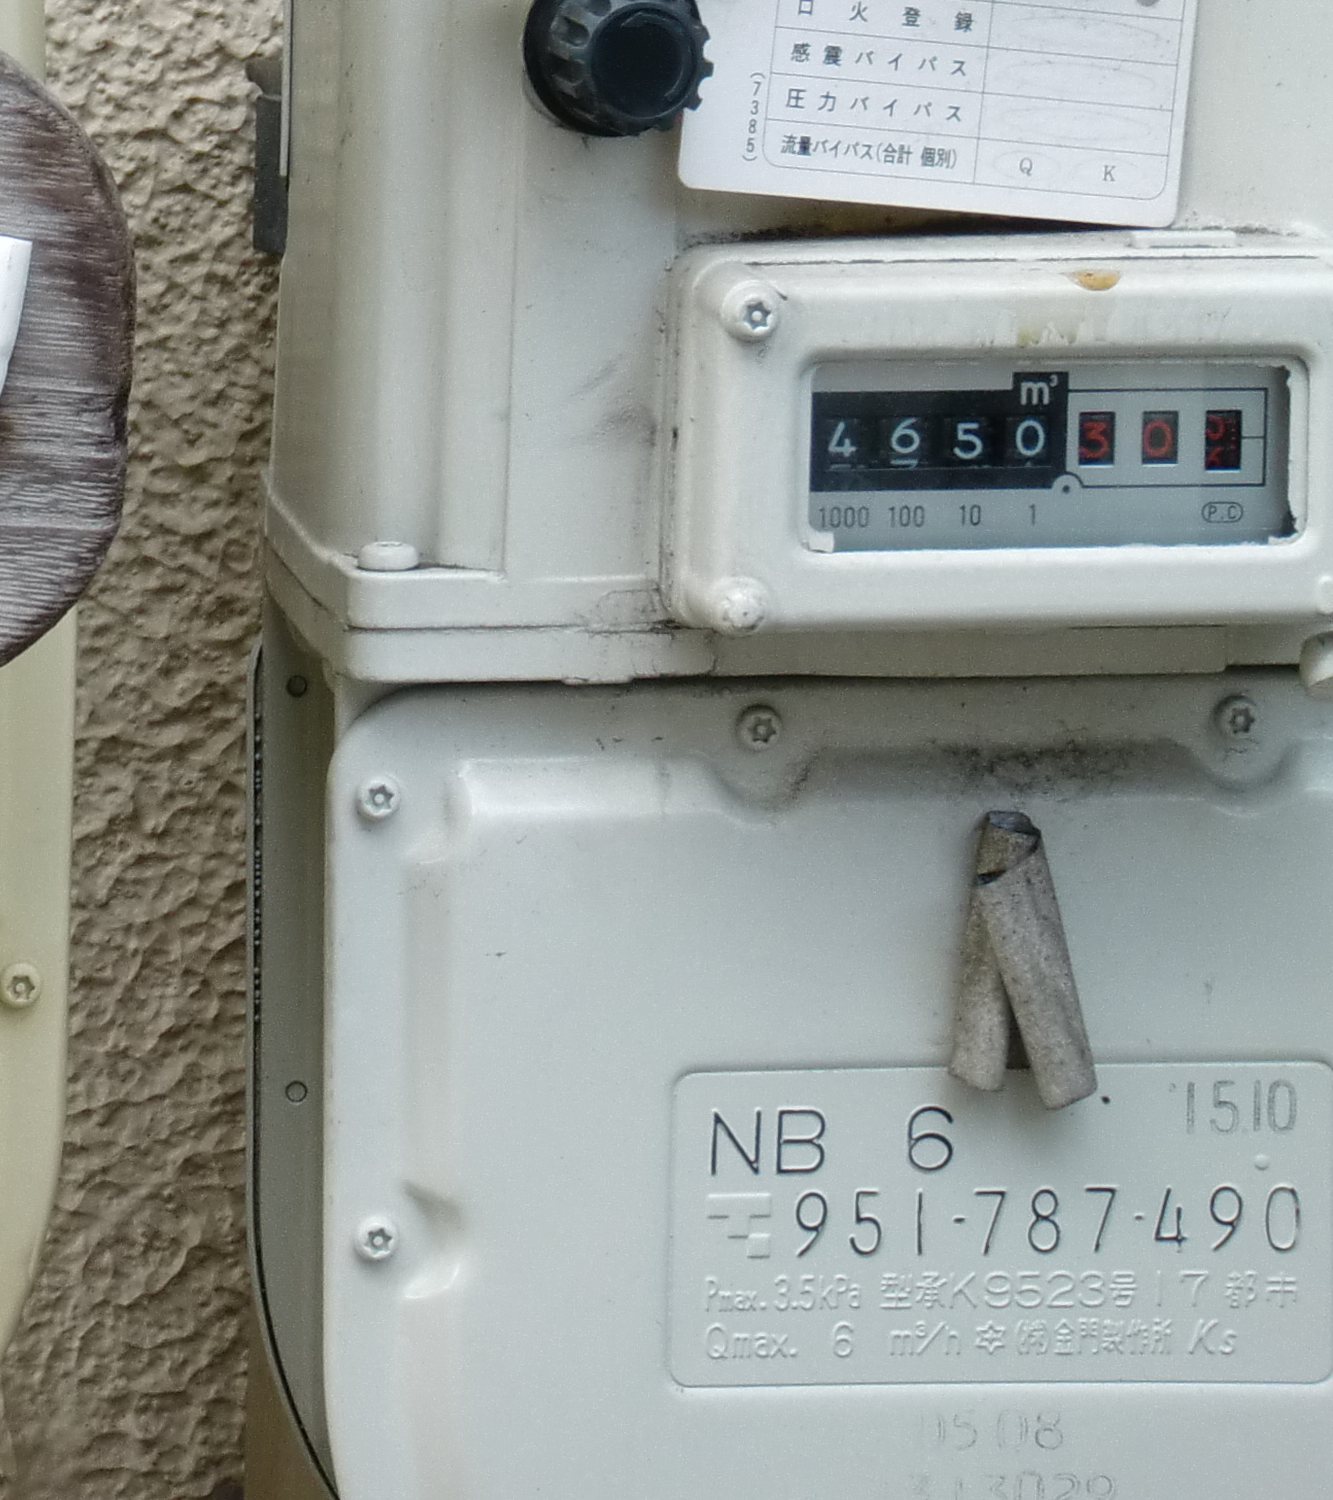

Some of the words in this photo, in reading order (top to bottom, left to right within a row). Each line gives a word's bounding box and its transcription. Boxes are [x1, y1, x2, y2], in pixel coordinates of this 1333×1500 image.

[1018, 158, 1033, 175] Q
[1103, 165, 1117, 182] K
[818, 506, 870, 529] 1000
[887, 505, 925, 528] 100
[959, 505, 982, 527] 10
[1027, 504, 1037, 526] 1
[711, 1106, 828, 1177] NB
[905, 1104, 955, 1176] 6
[795, 1185, 1302, 1258] 951-787-490
[704, 1321, 798, 1360] Qmax.
[832, 1320, 854, 1358] 6
